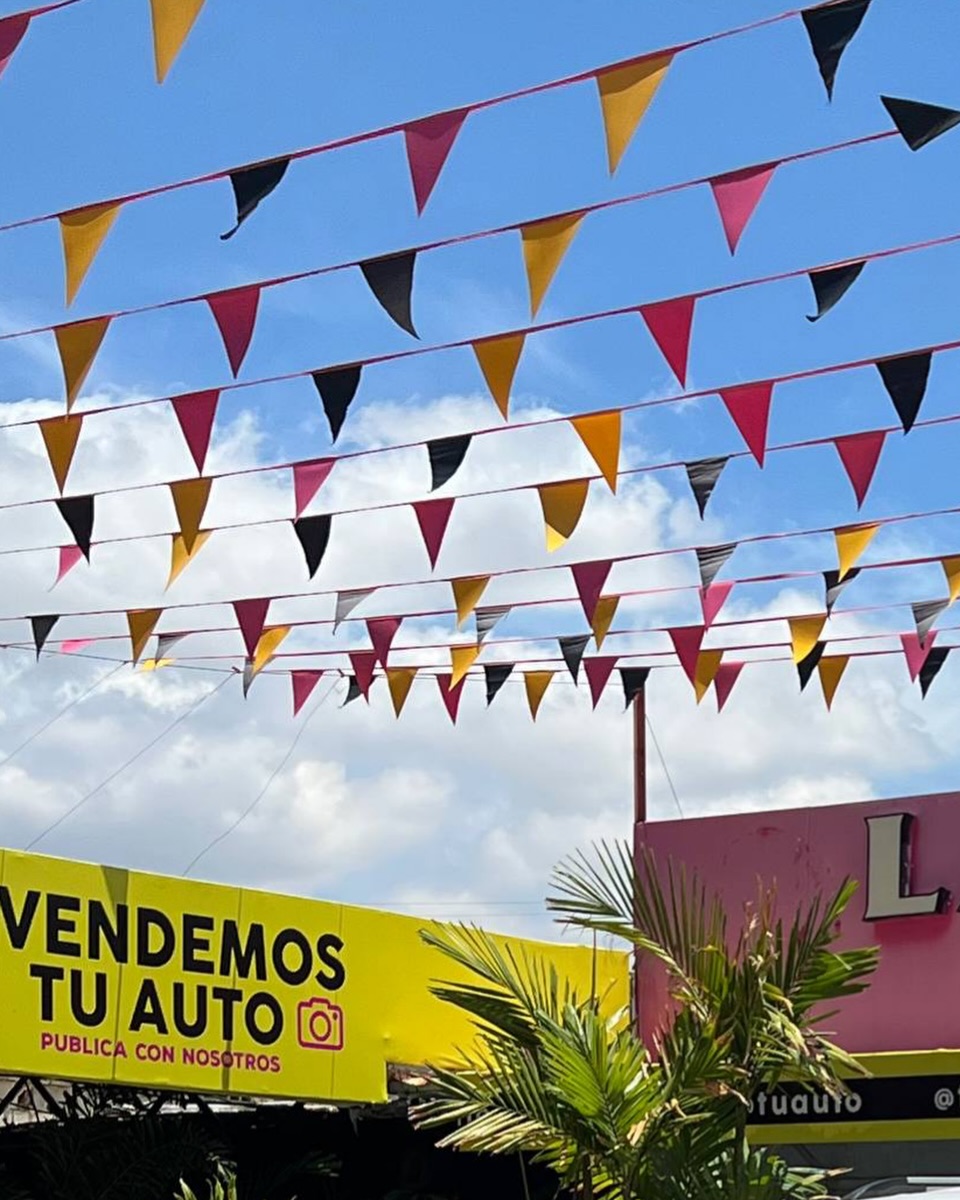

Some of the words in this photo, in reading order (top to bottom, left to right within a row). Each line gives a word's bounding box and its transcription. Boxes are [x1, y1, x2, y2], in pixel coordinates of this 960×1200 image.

[0, 885, 345, 991] VENDEMOS
[30, 963, 107, 1026] TU
[129, 978, 284, 1045] AUTO
[41, 1032, 127, 1058] PUBLICA
[136, 1043, 175, 1063] CON
[183, 1048, 281, 1073] NOSOTROS
